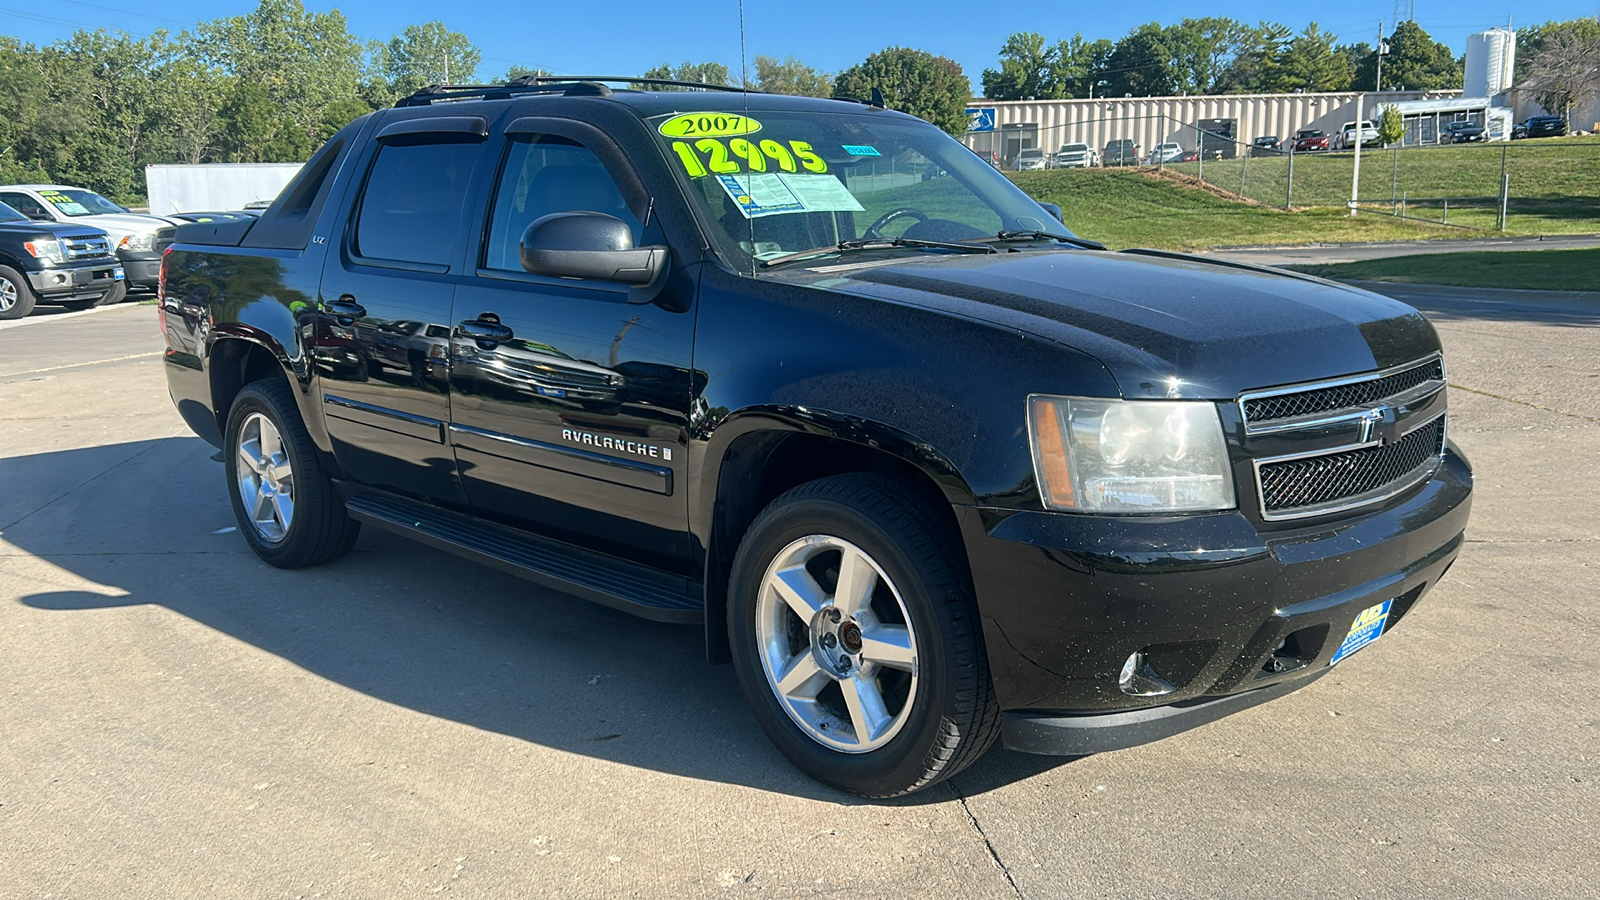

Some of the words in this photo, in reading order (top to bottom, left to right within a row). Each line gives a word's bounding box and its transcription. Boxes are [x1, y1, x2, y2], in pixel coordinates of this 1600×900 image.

[680, 116, 741, 135] 2007
[672, 138, 828, 178] 12995
[312, 236, 326, 244] LTZ
[562, 429, 659, 458] AVALANCHE
